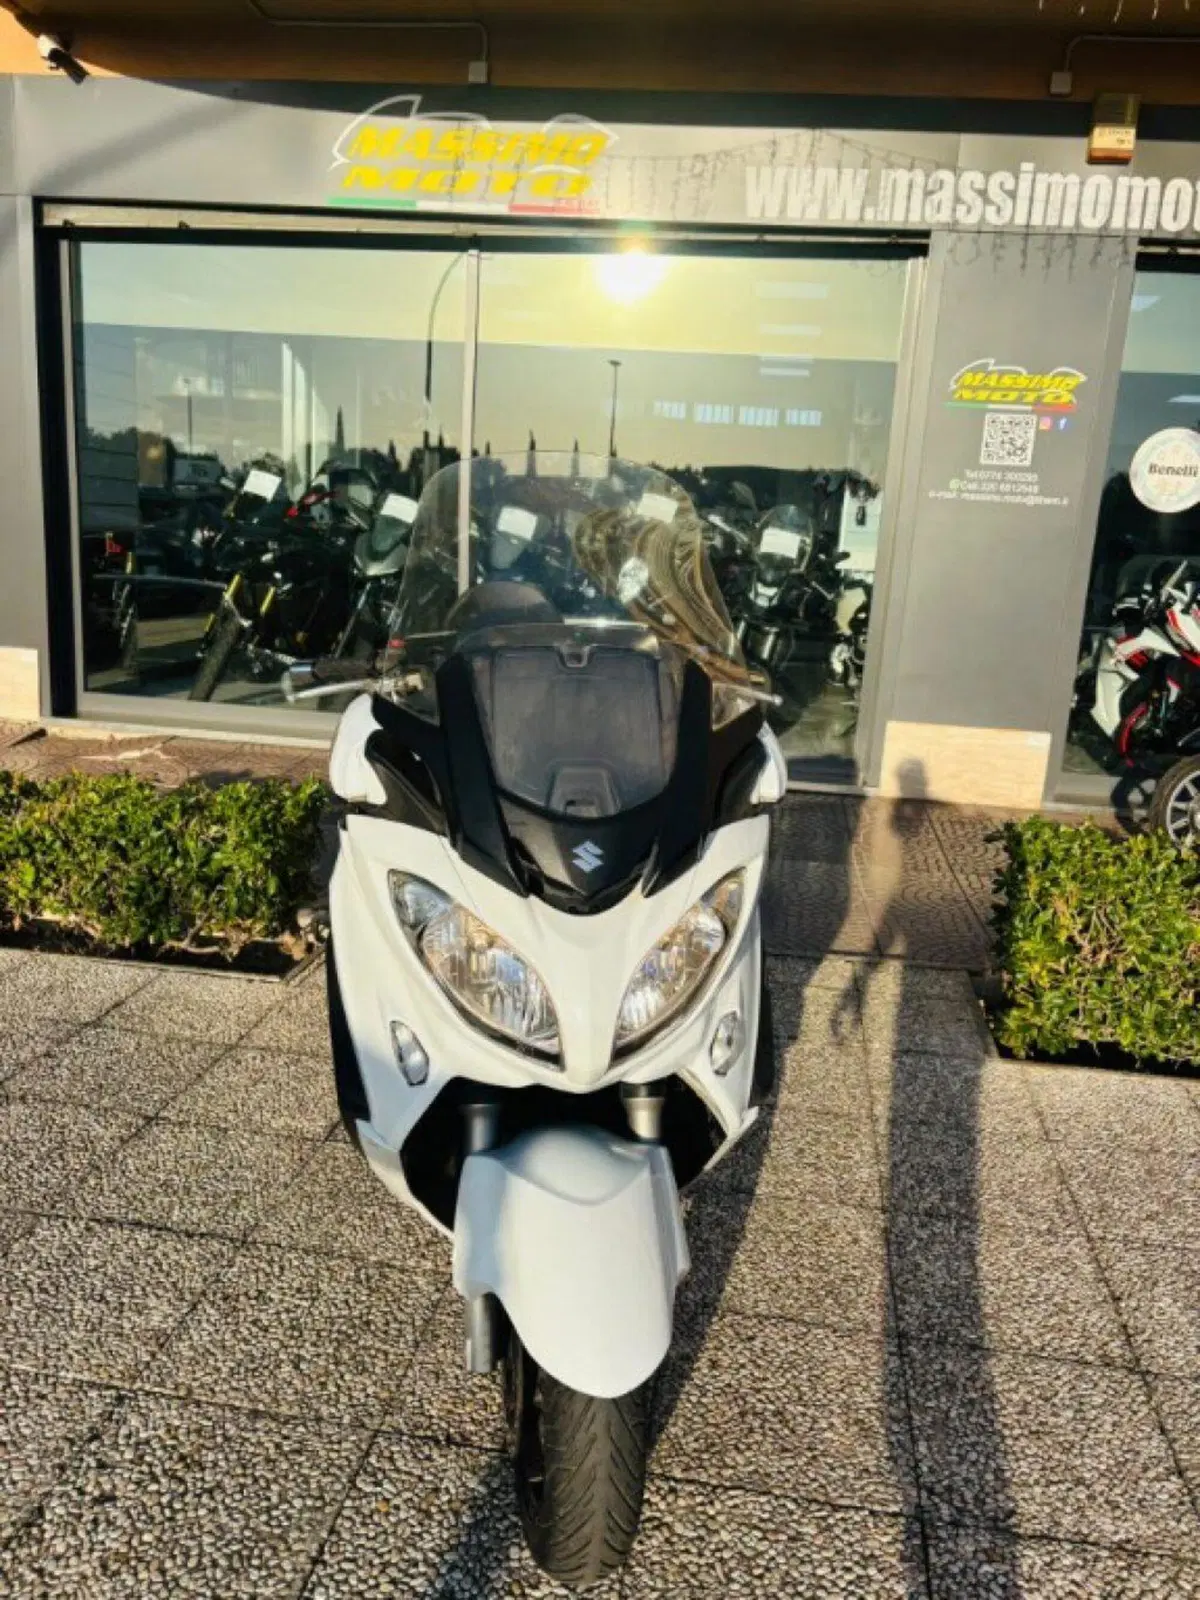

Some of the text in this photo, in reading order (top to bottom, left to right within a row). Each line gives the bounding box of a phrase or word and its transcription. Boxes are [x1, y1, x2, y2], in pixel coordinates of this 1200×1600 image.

[347, 126, 609, 166] MASSIMO
[341, 165, 593, 197] MOTO
[956, 371, 1082, 390] MASSIMO
[953, 388, 1073, 404] MOTO
[1148, 463, 1199, 478] Benelli
